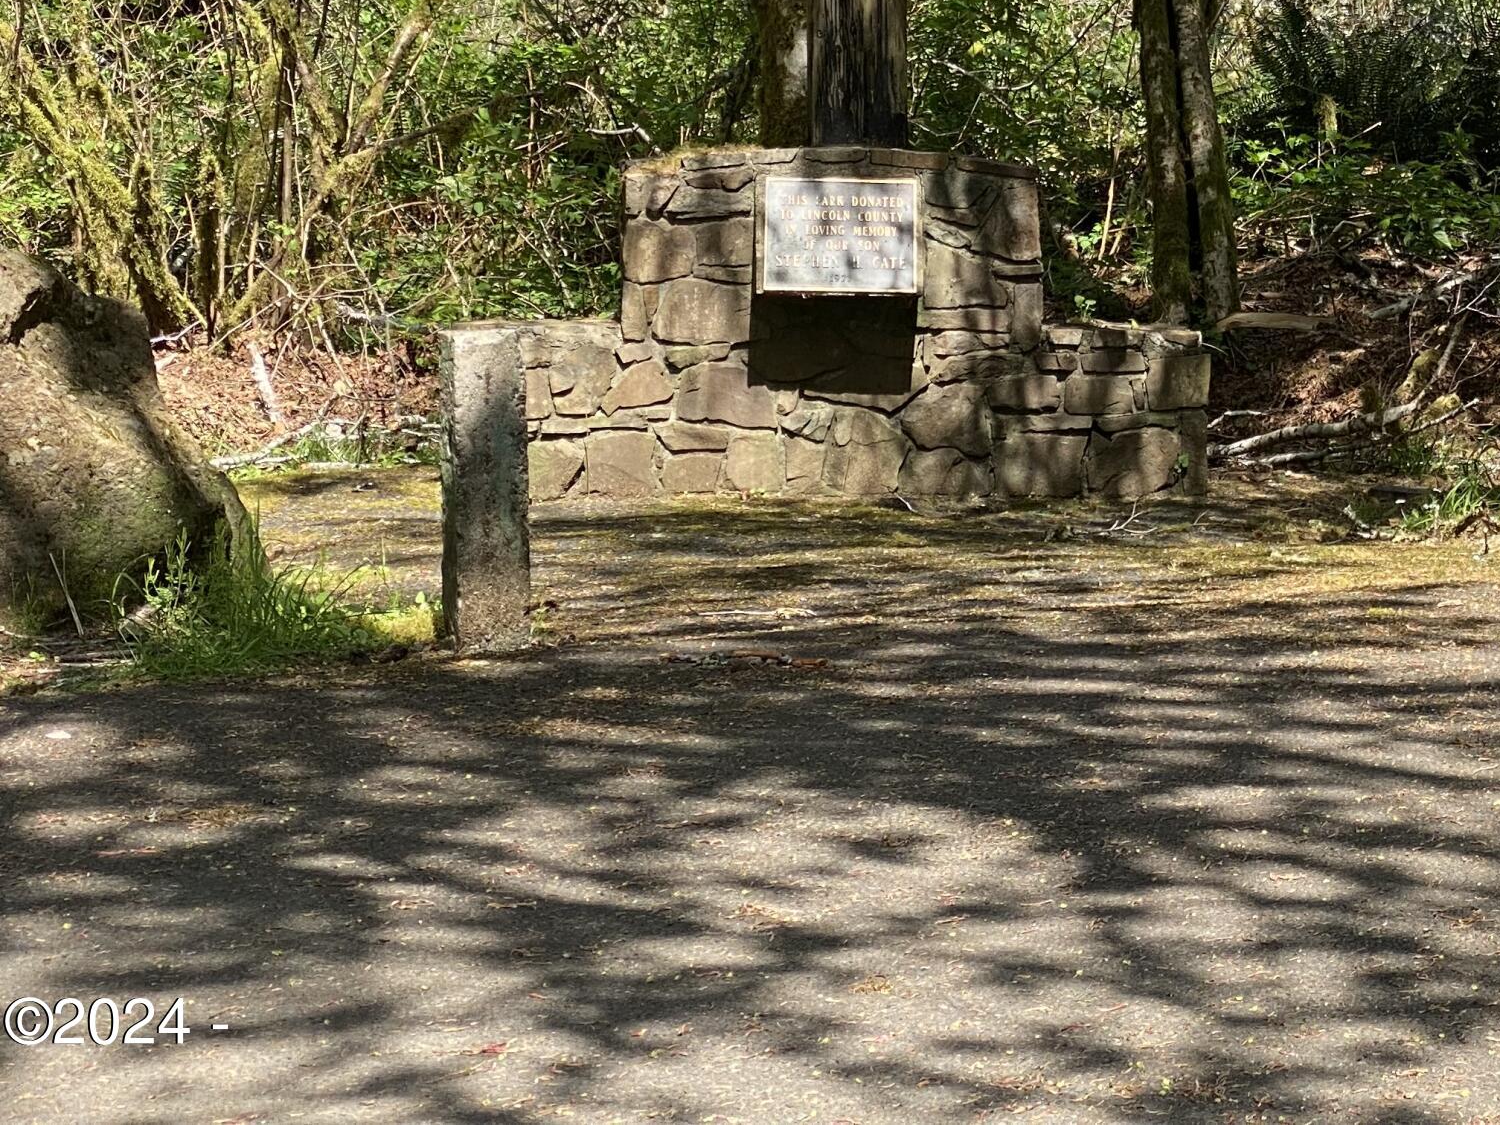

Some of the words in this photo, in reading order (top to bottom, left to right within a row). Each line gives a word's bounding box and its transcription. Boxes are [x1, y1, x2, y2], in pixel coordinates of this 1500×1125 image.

[851, 196, 904, 208] DONATED
[780, 210, 793, 221] TO
[802, 210, 850, 221] LINCOLN
[858, 211, 904, 222] COUNTY
[805, 225, 845, 236] LOVING
[853, 226, 897, 237] MEMORY
[858, 240, 880, 252] SON
